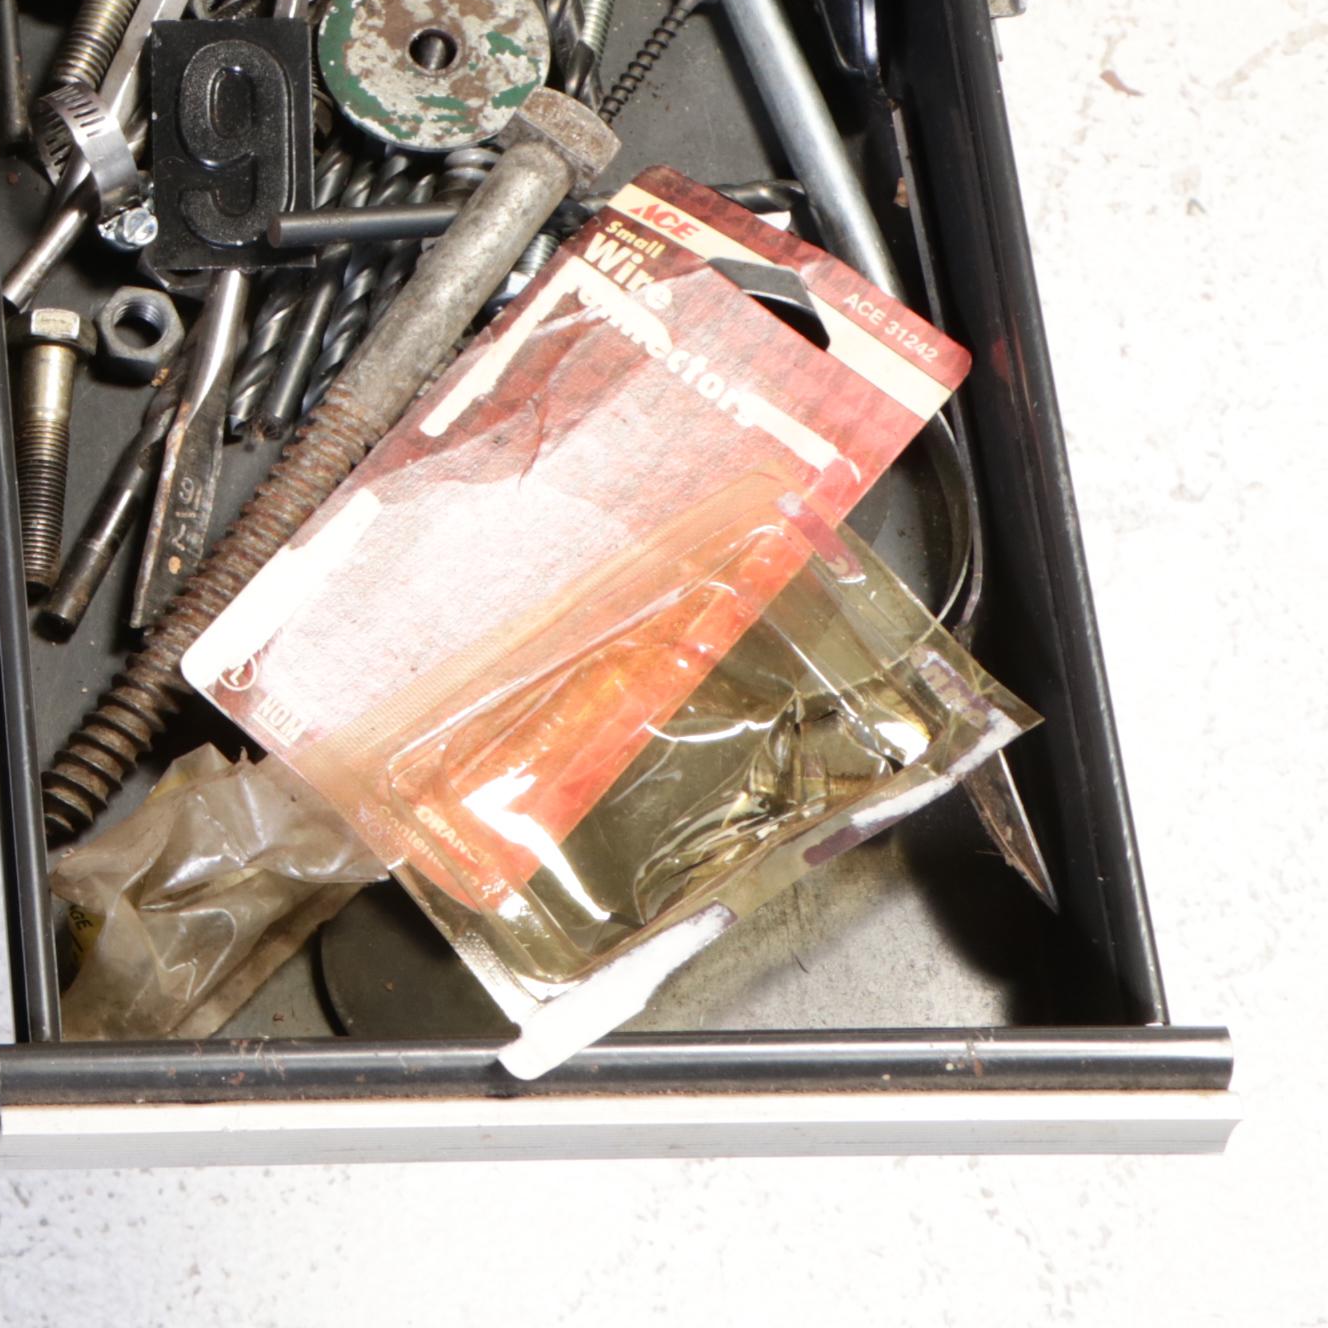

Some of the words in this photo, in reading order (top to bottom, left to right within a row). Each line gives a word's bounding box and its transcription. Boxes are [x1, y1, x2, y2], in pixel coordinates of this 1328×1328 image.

[605, 220, 666, 259] Small
[630, 203, 699, 241] ACE
[584, 232, 672, 309] Wire
[842, 292, 887, 326] ACE
[884, 319, 939, 363] 31242
[260, 696, 307, 741] NOM
